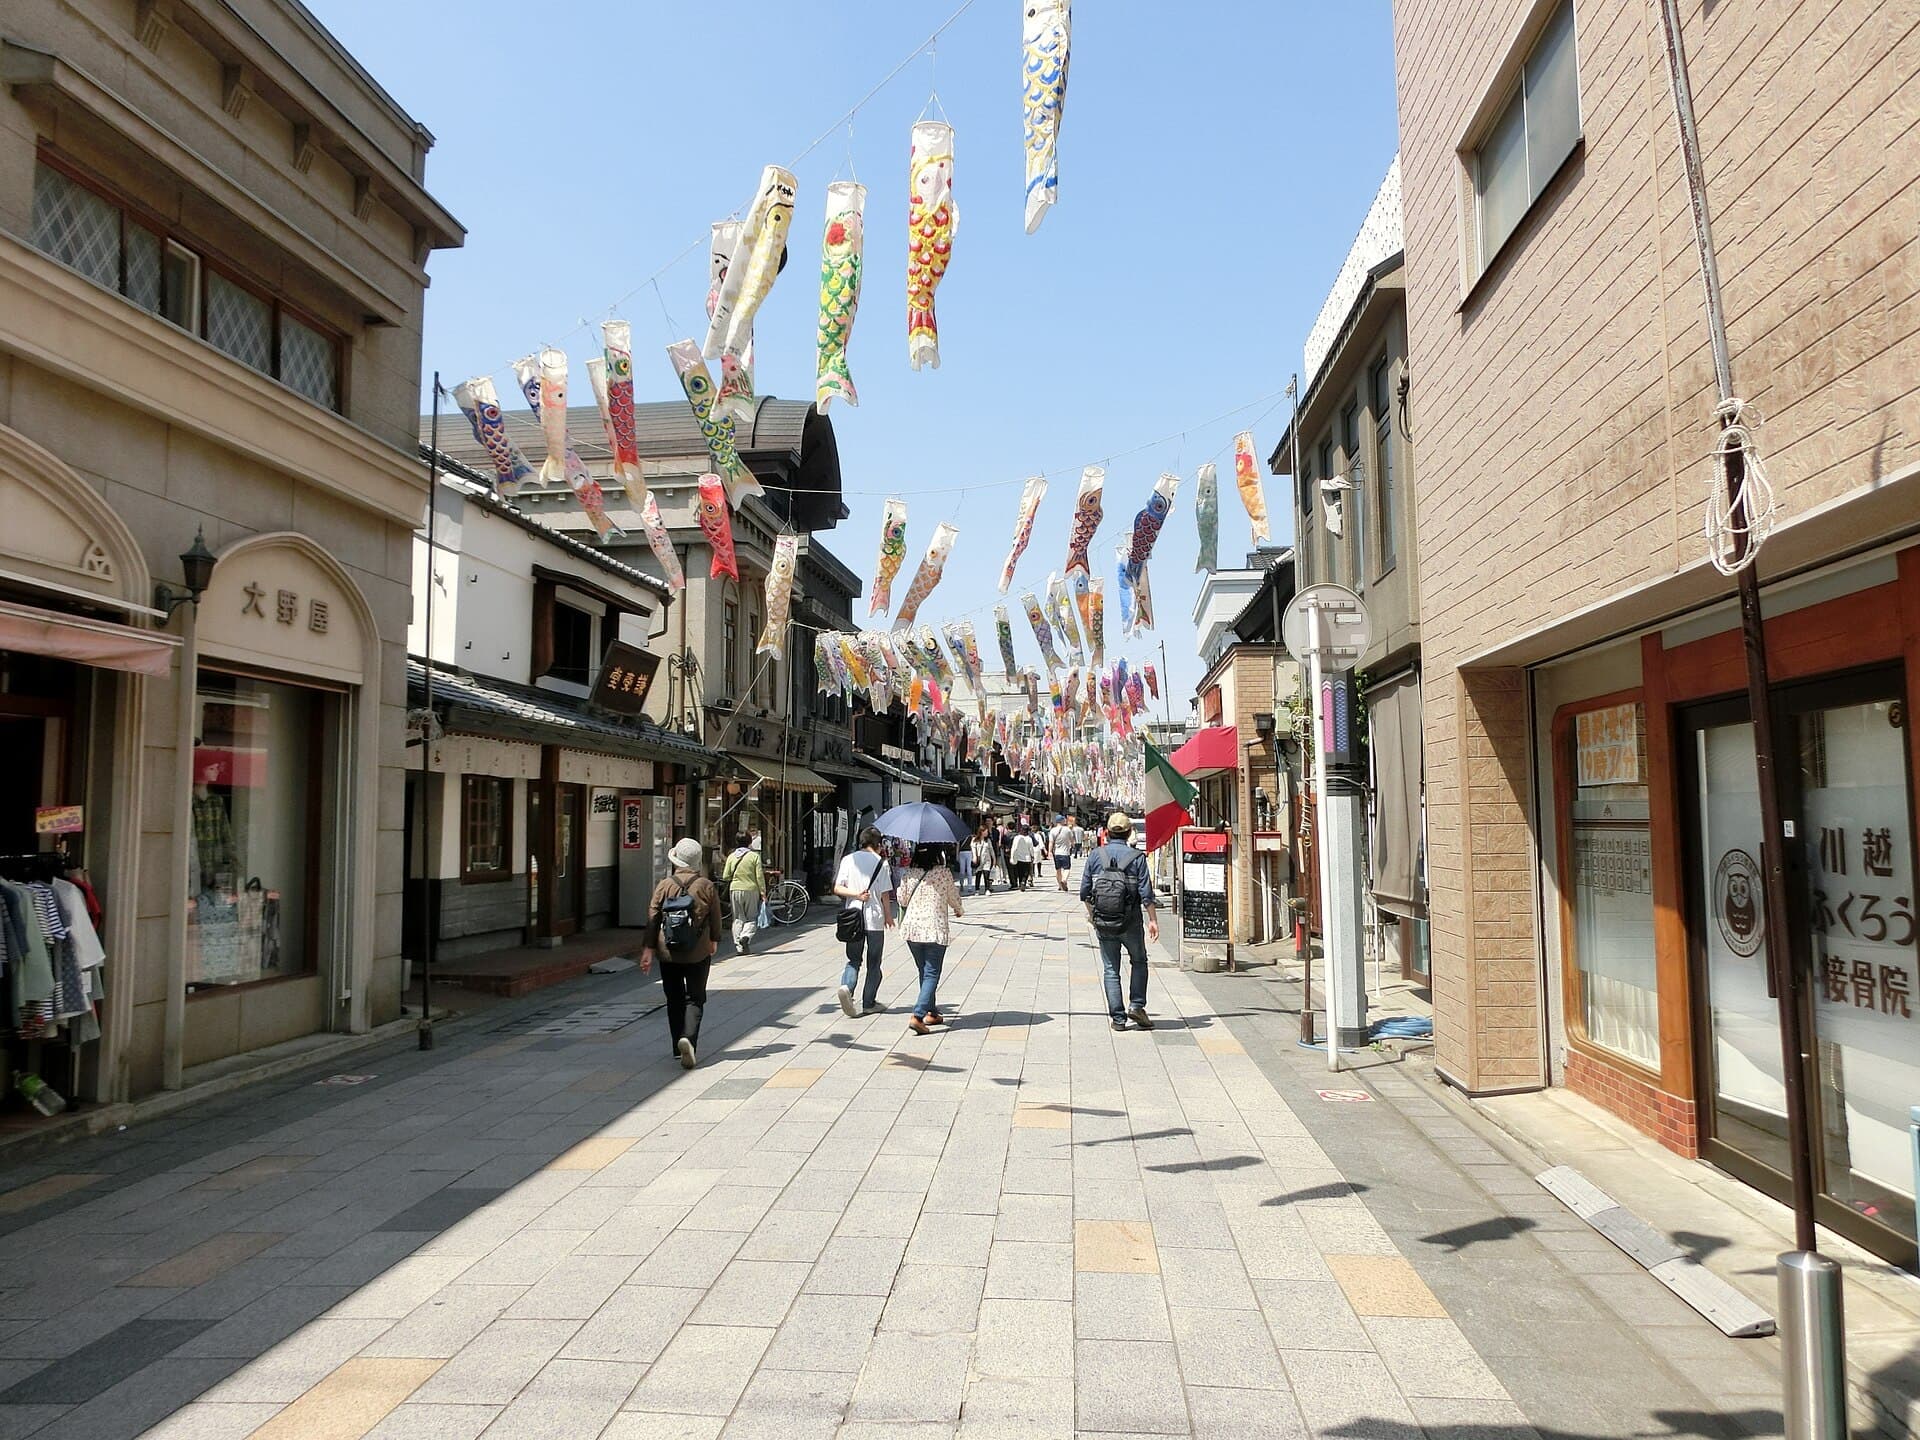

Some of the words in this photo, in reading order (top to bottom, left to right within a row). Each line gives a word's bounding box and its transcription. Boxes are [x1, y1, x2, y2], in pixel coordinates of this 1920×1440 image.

[242, 581, 329, 634] 大野屋
[626, 805, 641, 844] 教科書
[677, 787, 685, 825] たばこ
[1820, 827, 1893, 878] 川越
[1812, 888, 1915, 946] ふくろう
[1823, 953, 1911, 1020] 接骨院
